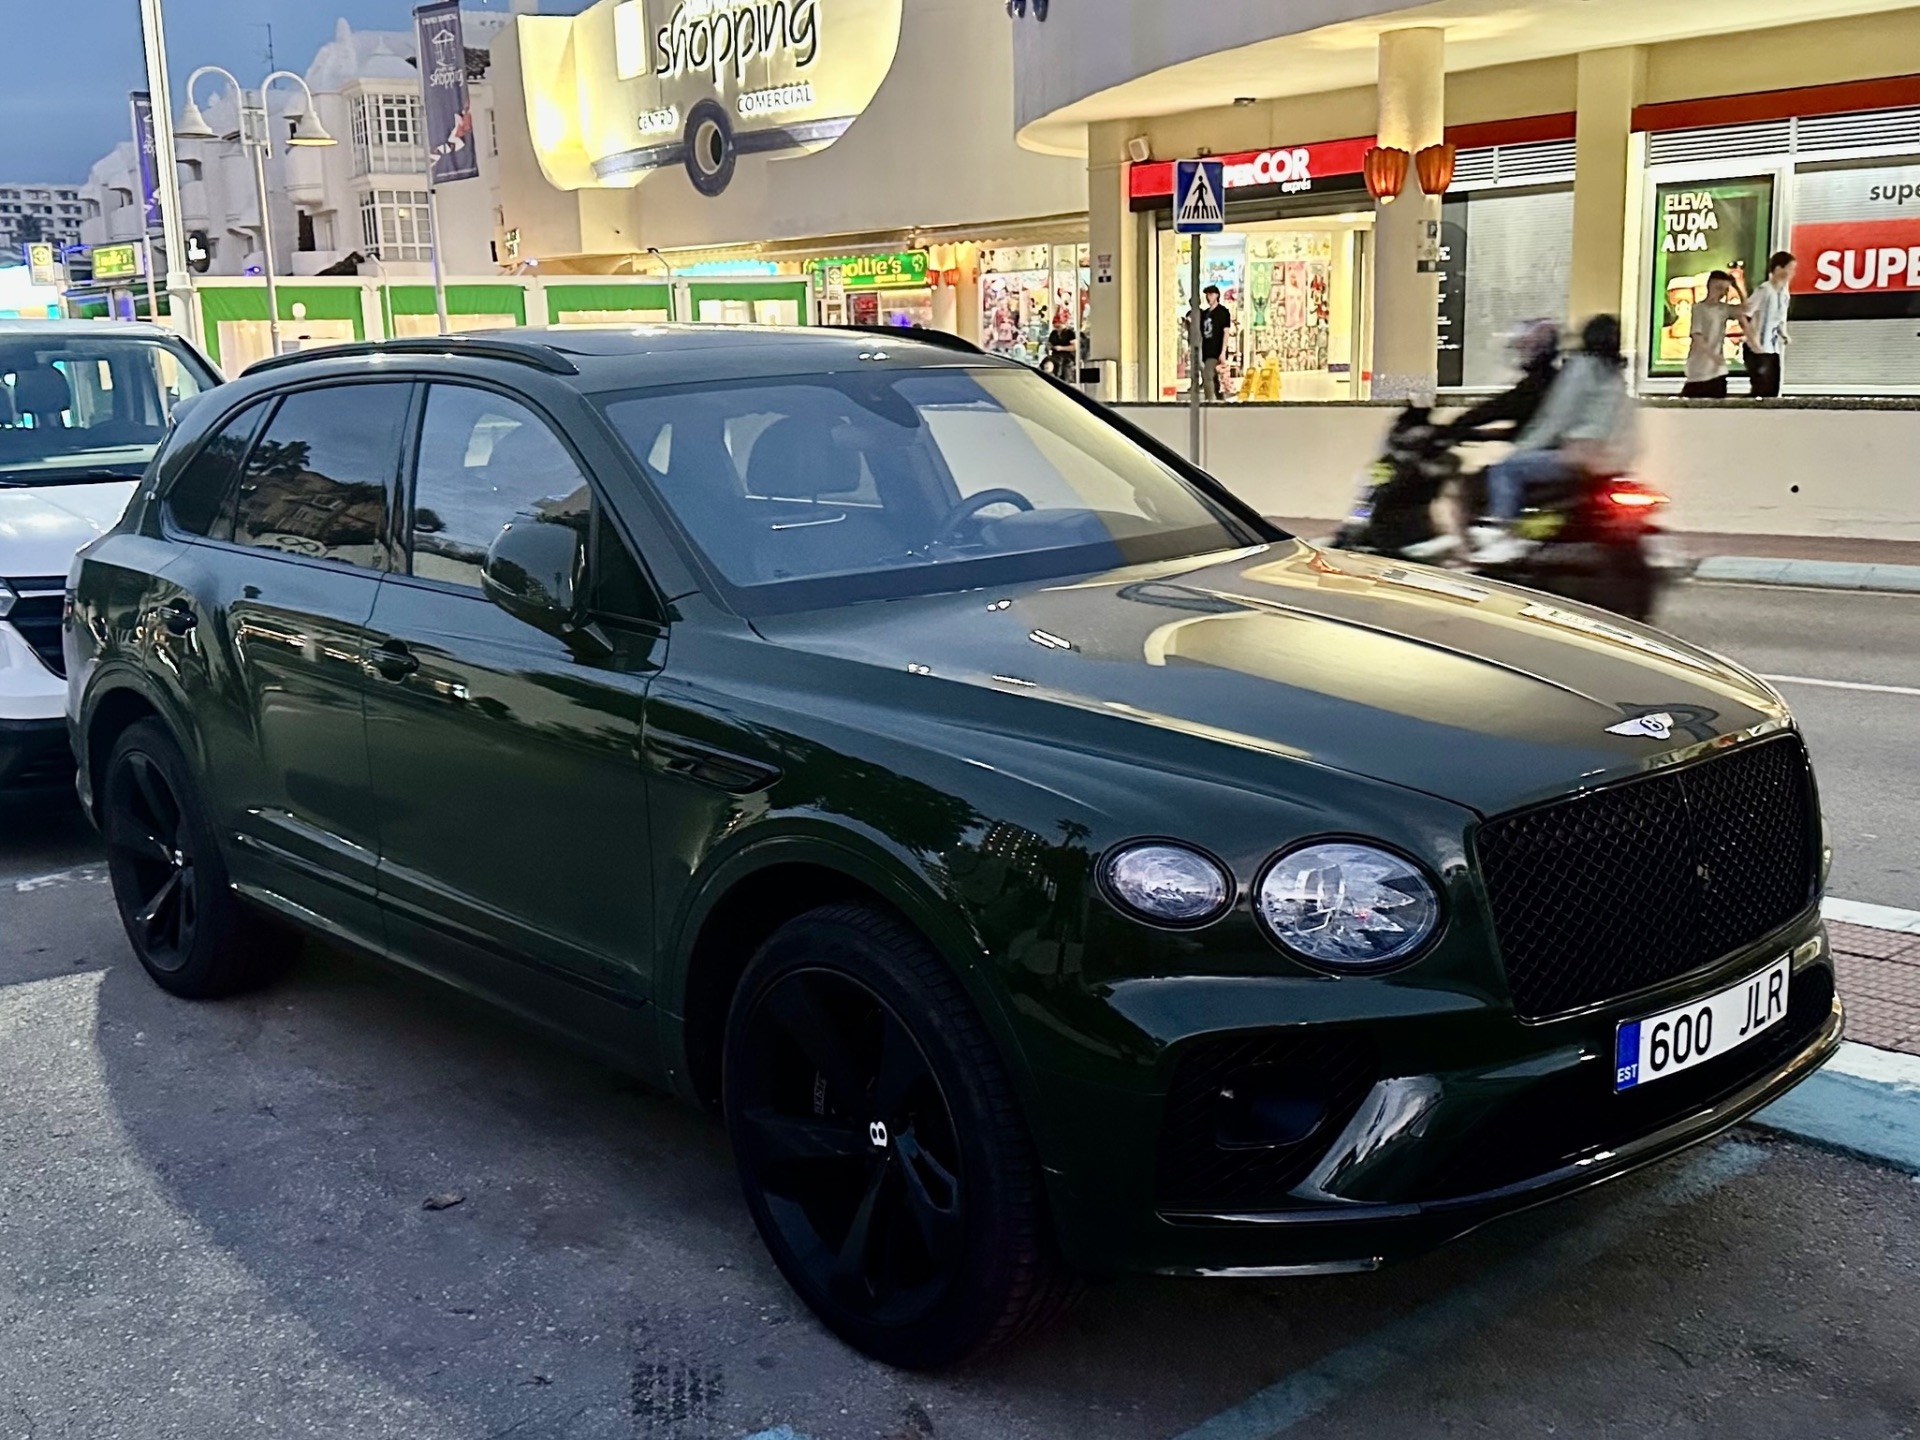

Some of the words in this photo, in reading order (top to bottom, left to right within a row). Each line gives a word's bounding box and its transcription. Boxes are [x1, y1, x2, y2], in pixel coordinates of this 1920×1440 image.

[656, 0, 817, 84] shopping
[737, 86, 812, 114] COMERCIAL
[1664, 191, 1714, 212] ELEVA
[1663, 213, 1686, 232] TU
[1686, 208, 1719, 231] DÍA
[1661, 234, 1676, 253] A
[1676, 229, 1708, 252] DÍA
[842, 256, 902, 278] ollie's
[1650, 1006, 1713, 1072] 600
[1739, 968, 1783, 1036] JLR
[1617, 1063, 1638, 1083] EST
